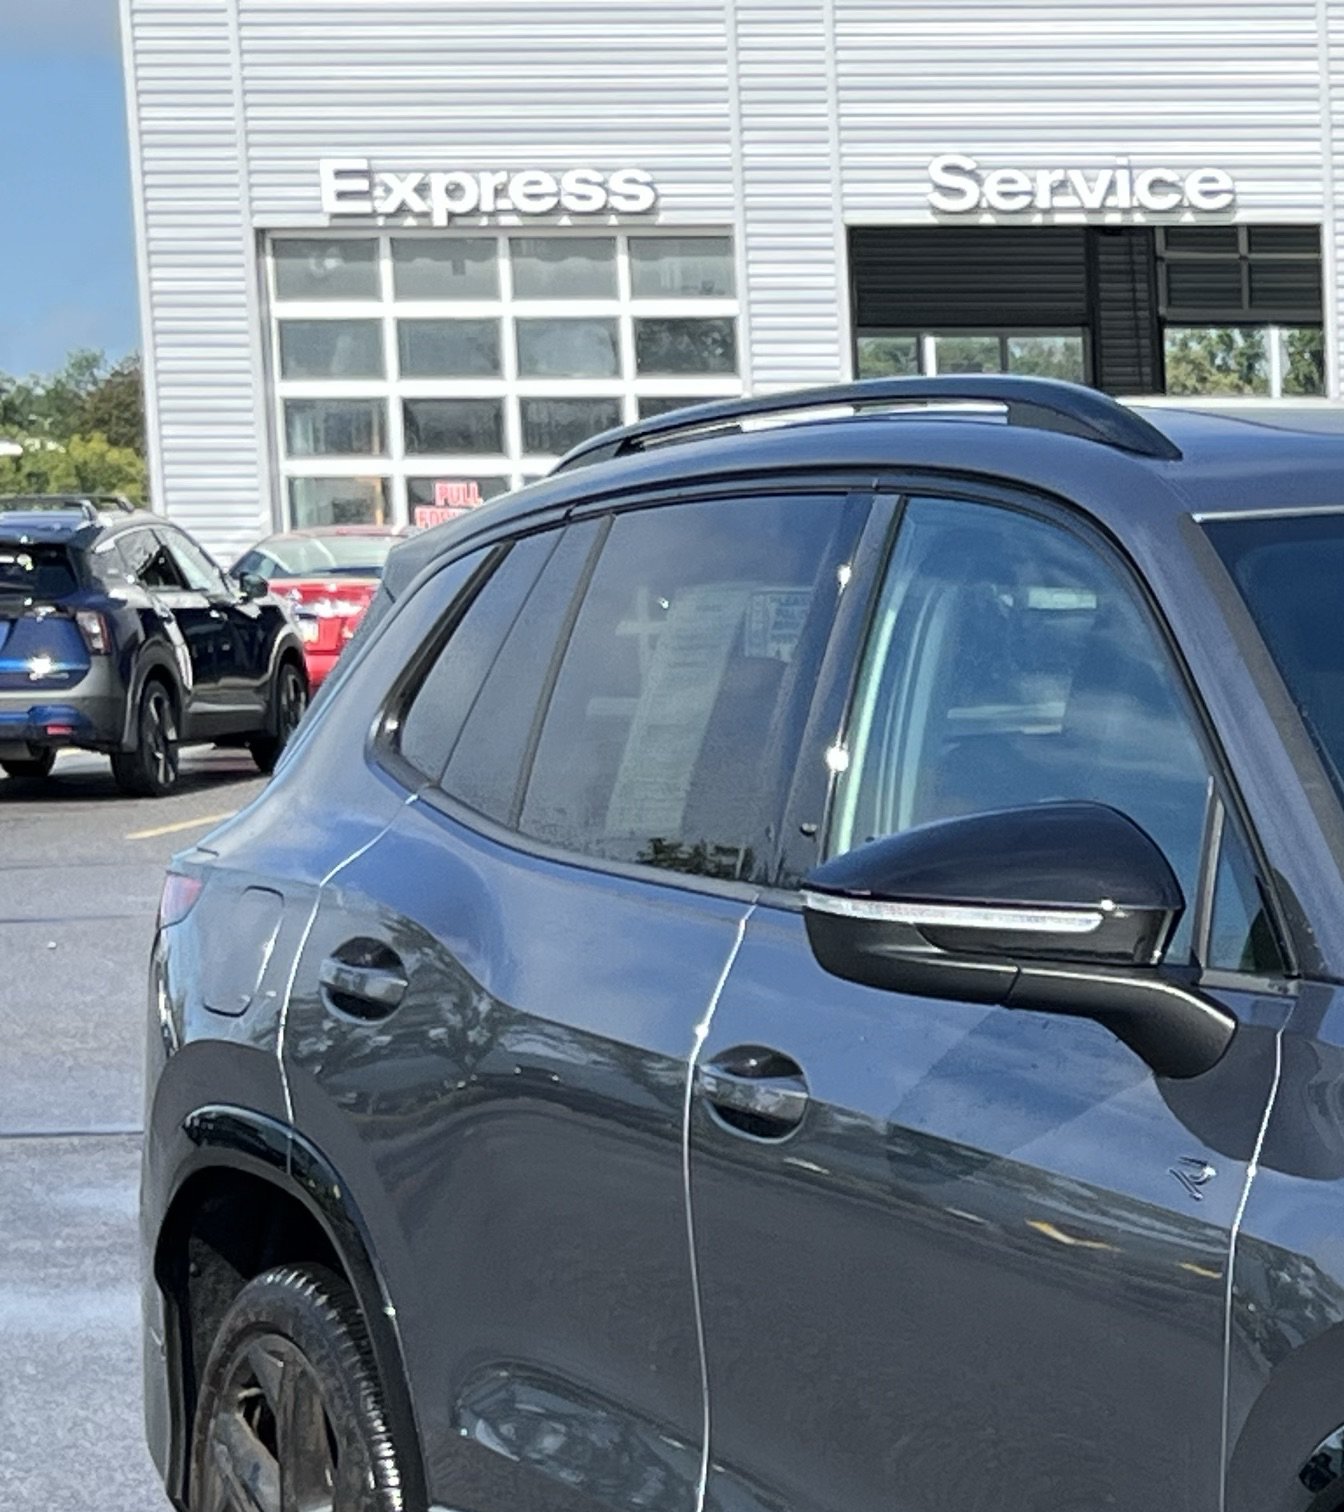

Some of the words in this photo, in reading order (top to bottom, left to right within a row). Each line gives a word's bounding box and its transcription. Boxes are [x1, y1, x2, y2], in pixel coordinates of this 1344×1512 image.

[319, 158, 656, 227] Express
[926, 154, 1235, 213] Service
[437, 481, 481, 505] PULL
